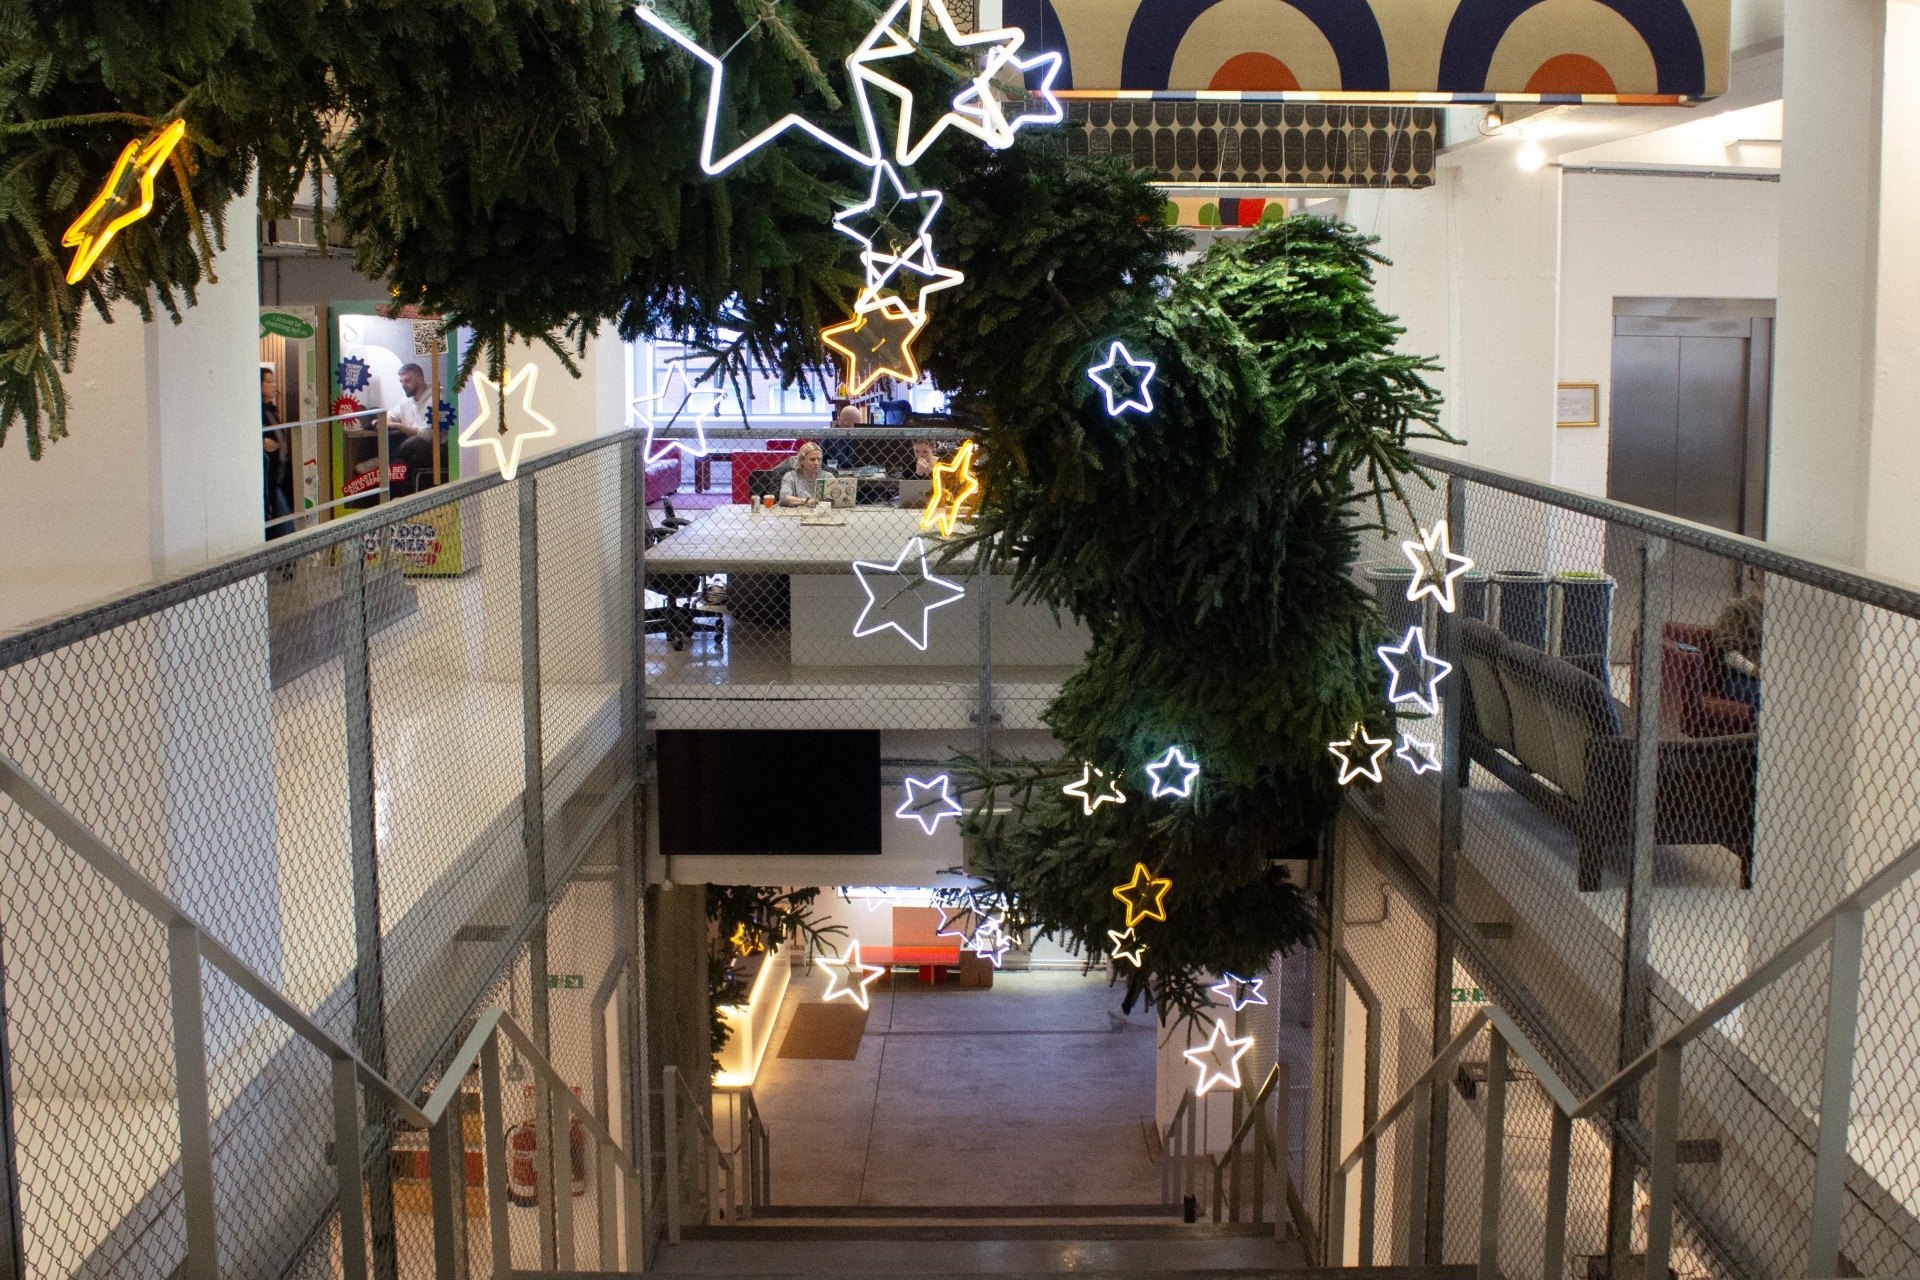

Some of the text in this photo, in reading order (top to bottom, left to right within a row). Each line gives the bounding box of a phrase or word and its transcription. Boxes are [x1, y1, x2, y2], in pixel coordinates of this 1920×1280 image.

[343, 471, 375, 493] CARHARTT
[392, 465, 407, 473] BED
[349, 483, 366, 495] SOLD
[398, 524, 435, 539] DOG
[364, 538, 427, 552] ONER
